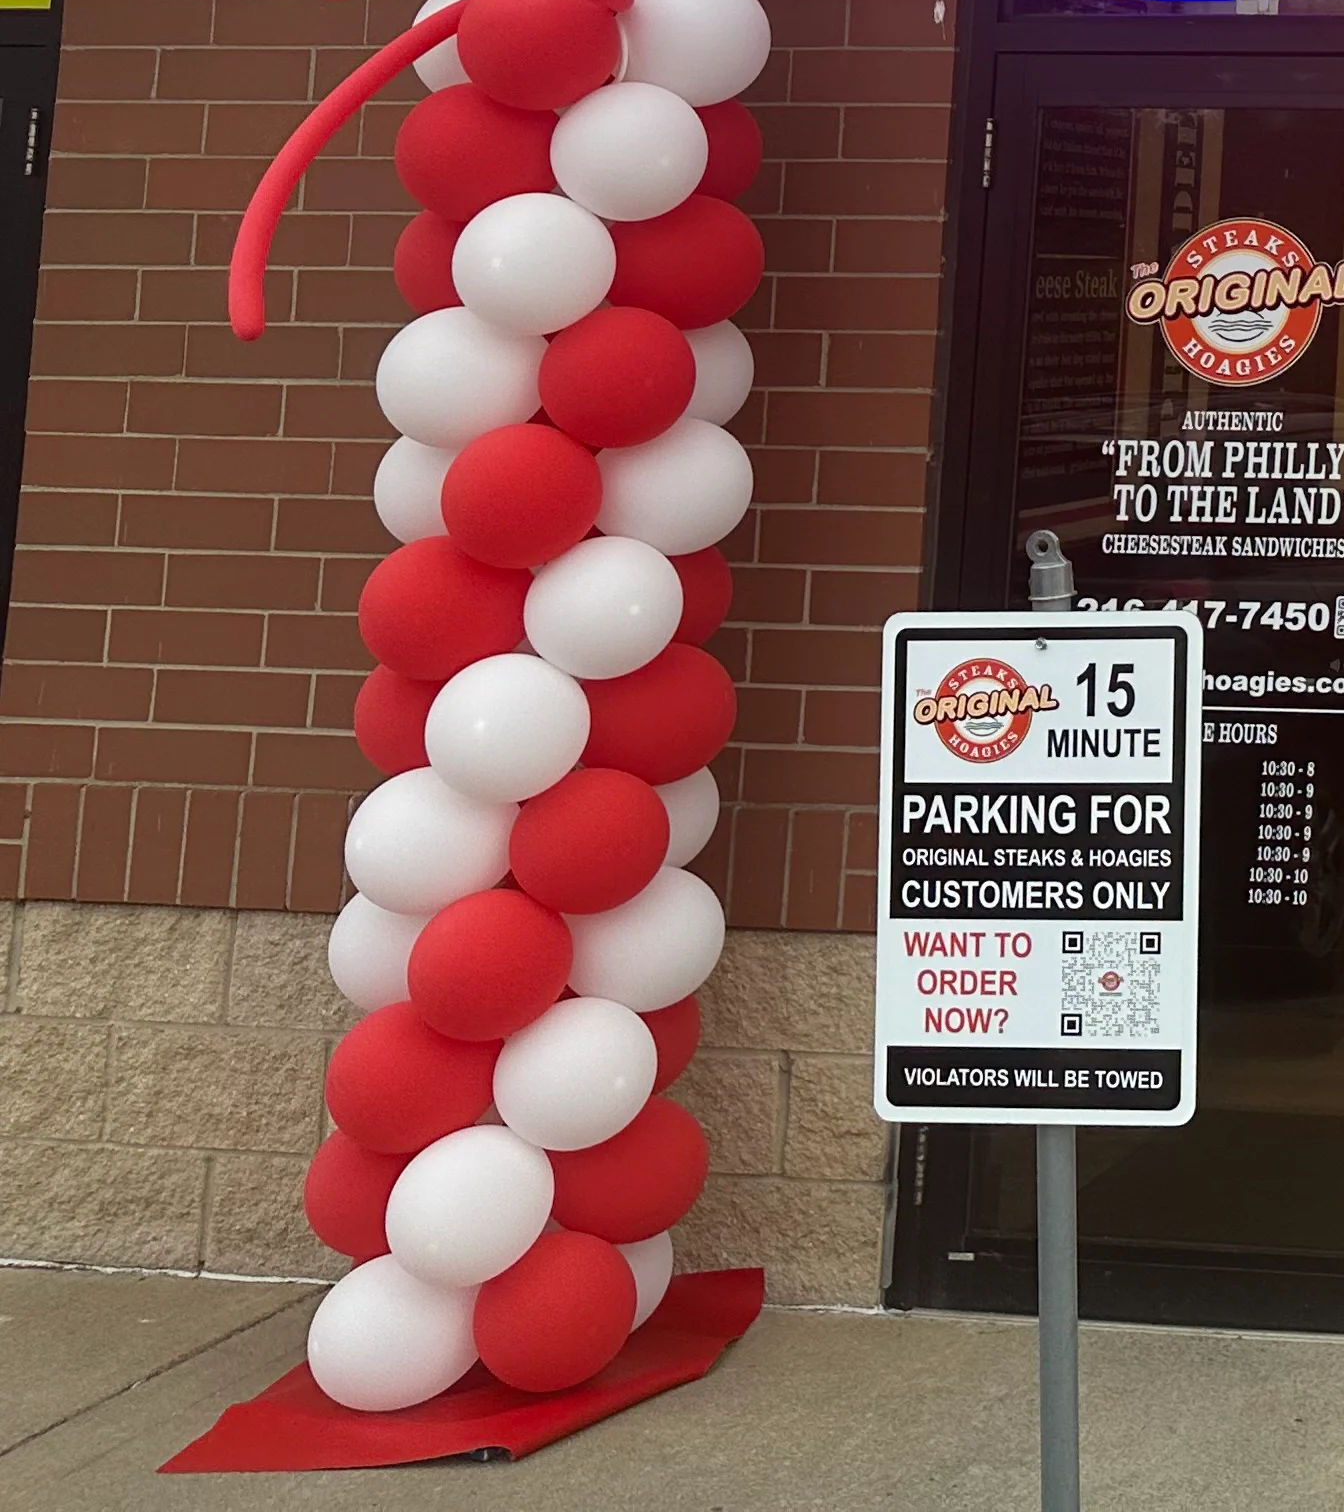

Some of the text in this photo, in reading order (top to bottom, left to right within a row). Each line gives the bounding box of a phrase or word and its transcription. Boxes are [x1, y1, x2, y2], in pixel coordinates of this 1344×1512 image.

[1186, 230, 1300, 268] STEAKS
[1074, 268, 1118, 299] Steak
[1130, 261, 1160, 279] The
[1182, 334, 1296, 377] HOAGIES
[1181, 411, 1283, 432] AUTHENTIC
[1101, 440, 1212, 478] “FROM
[1113, 484, 1157, 522] TO
[1167, 485, 1237, 523] THE
[1102, 533, 1228, 556] CHEESESTEAK
[948, 665, 1018, 692] STEAKS
[1076, 663, 1135, 717] 15
[914, 685, 1058, 724] ORIGINAL
[916, 688, 931, 697] The
[948, 731, 1018, 759] HOAGIES
[1047, 729, 1161, 758] MINUTE
[1218, 723, 1278, 746] HOURS
[1261, 761, 1296, 776] 10:30
[1306, 761, 1315, 777] 8
[1260, 782, 1294, 797] 10:30
[1306, 783, 1315, 799] 9
[902, 794, 1172, 835] PARKING FOR
[1259, 804, 1293, 819] 10:30
[1304, 804, 1313, 820] 9
[1258, 825, 1292, 840] 10:30
[1303, 826, 1312, 842] 9
[902, 847, 1172, 868] ORIGINAL STEAKS & HOAGIES
[1257, 846, 1291, 861] 10:30
[1302, 847, 1311, 863] 9
[1249, 867, 1283, 882] 10:30
[1293, 869, 1308, 885] 10
[901, 880, 1171, 910] CUSTOMERS ONLY
[1248, 889, 1282, 904] 10:30
[1292, 890, 1307, 906] 10
[904, 931, 1032, 958] WANT TO
[917, 969, 1018, 996] ORDER
[924, 1007, 1009, 1034] NOW?
[904, 1068, 1164, 1090] VIOLATORS WILL BE TOWED
